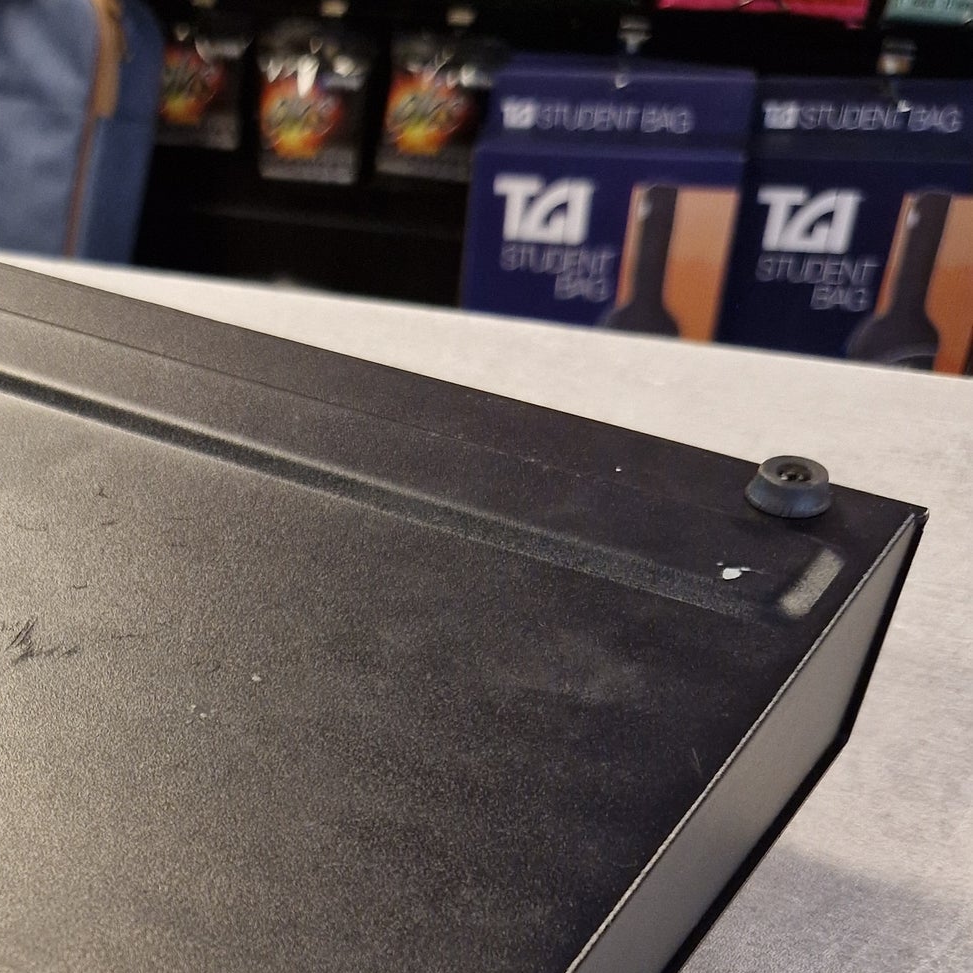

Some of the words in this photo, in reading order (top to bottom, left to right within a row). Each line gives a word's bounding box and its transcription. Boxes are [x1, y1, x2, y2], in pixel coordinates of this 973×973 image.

[537, 103, 640, 131] STUDENT
[641, 105, 694, 134] BAG
[800, 104, 904, 131] STUDENT
[907, 104, 963, 134] BAG
[502, 245, 616, 275] STUDENT
[755, 254, 880, 286] STUDENT
[554, 270, 608, 302] BAG
[810, 283, 869, 312] BAG
